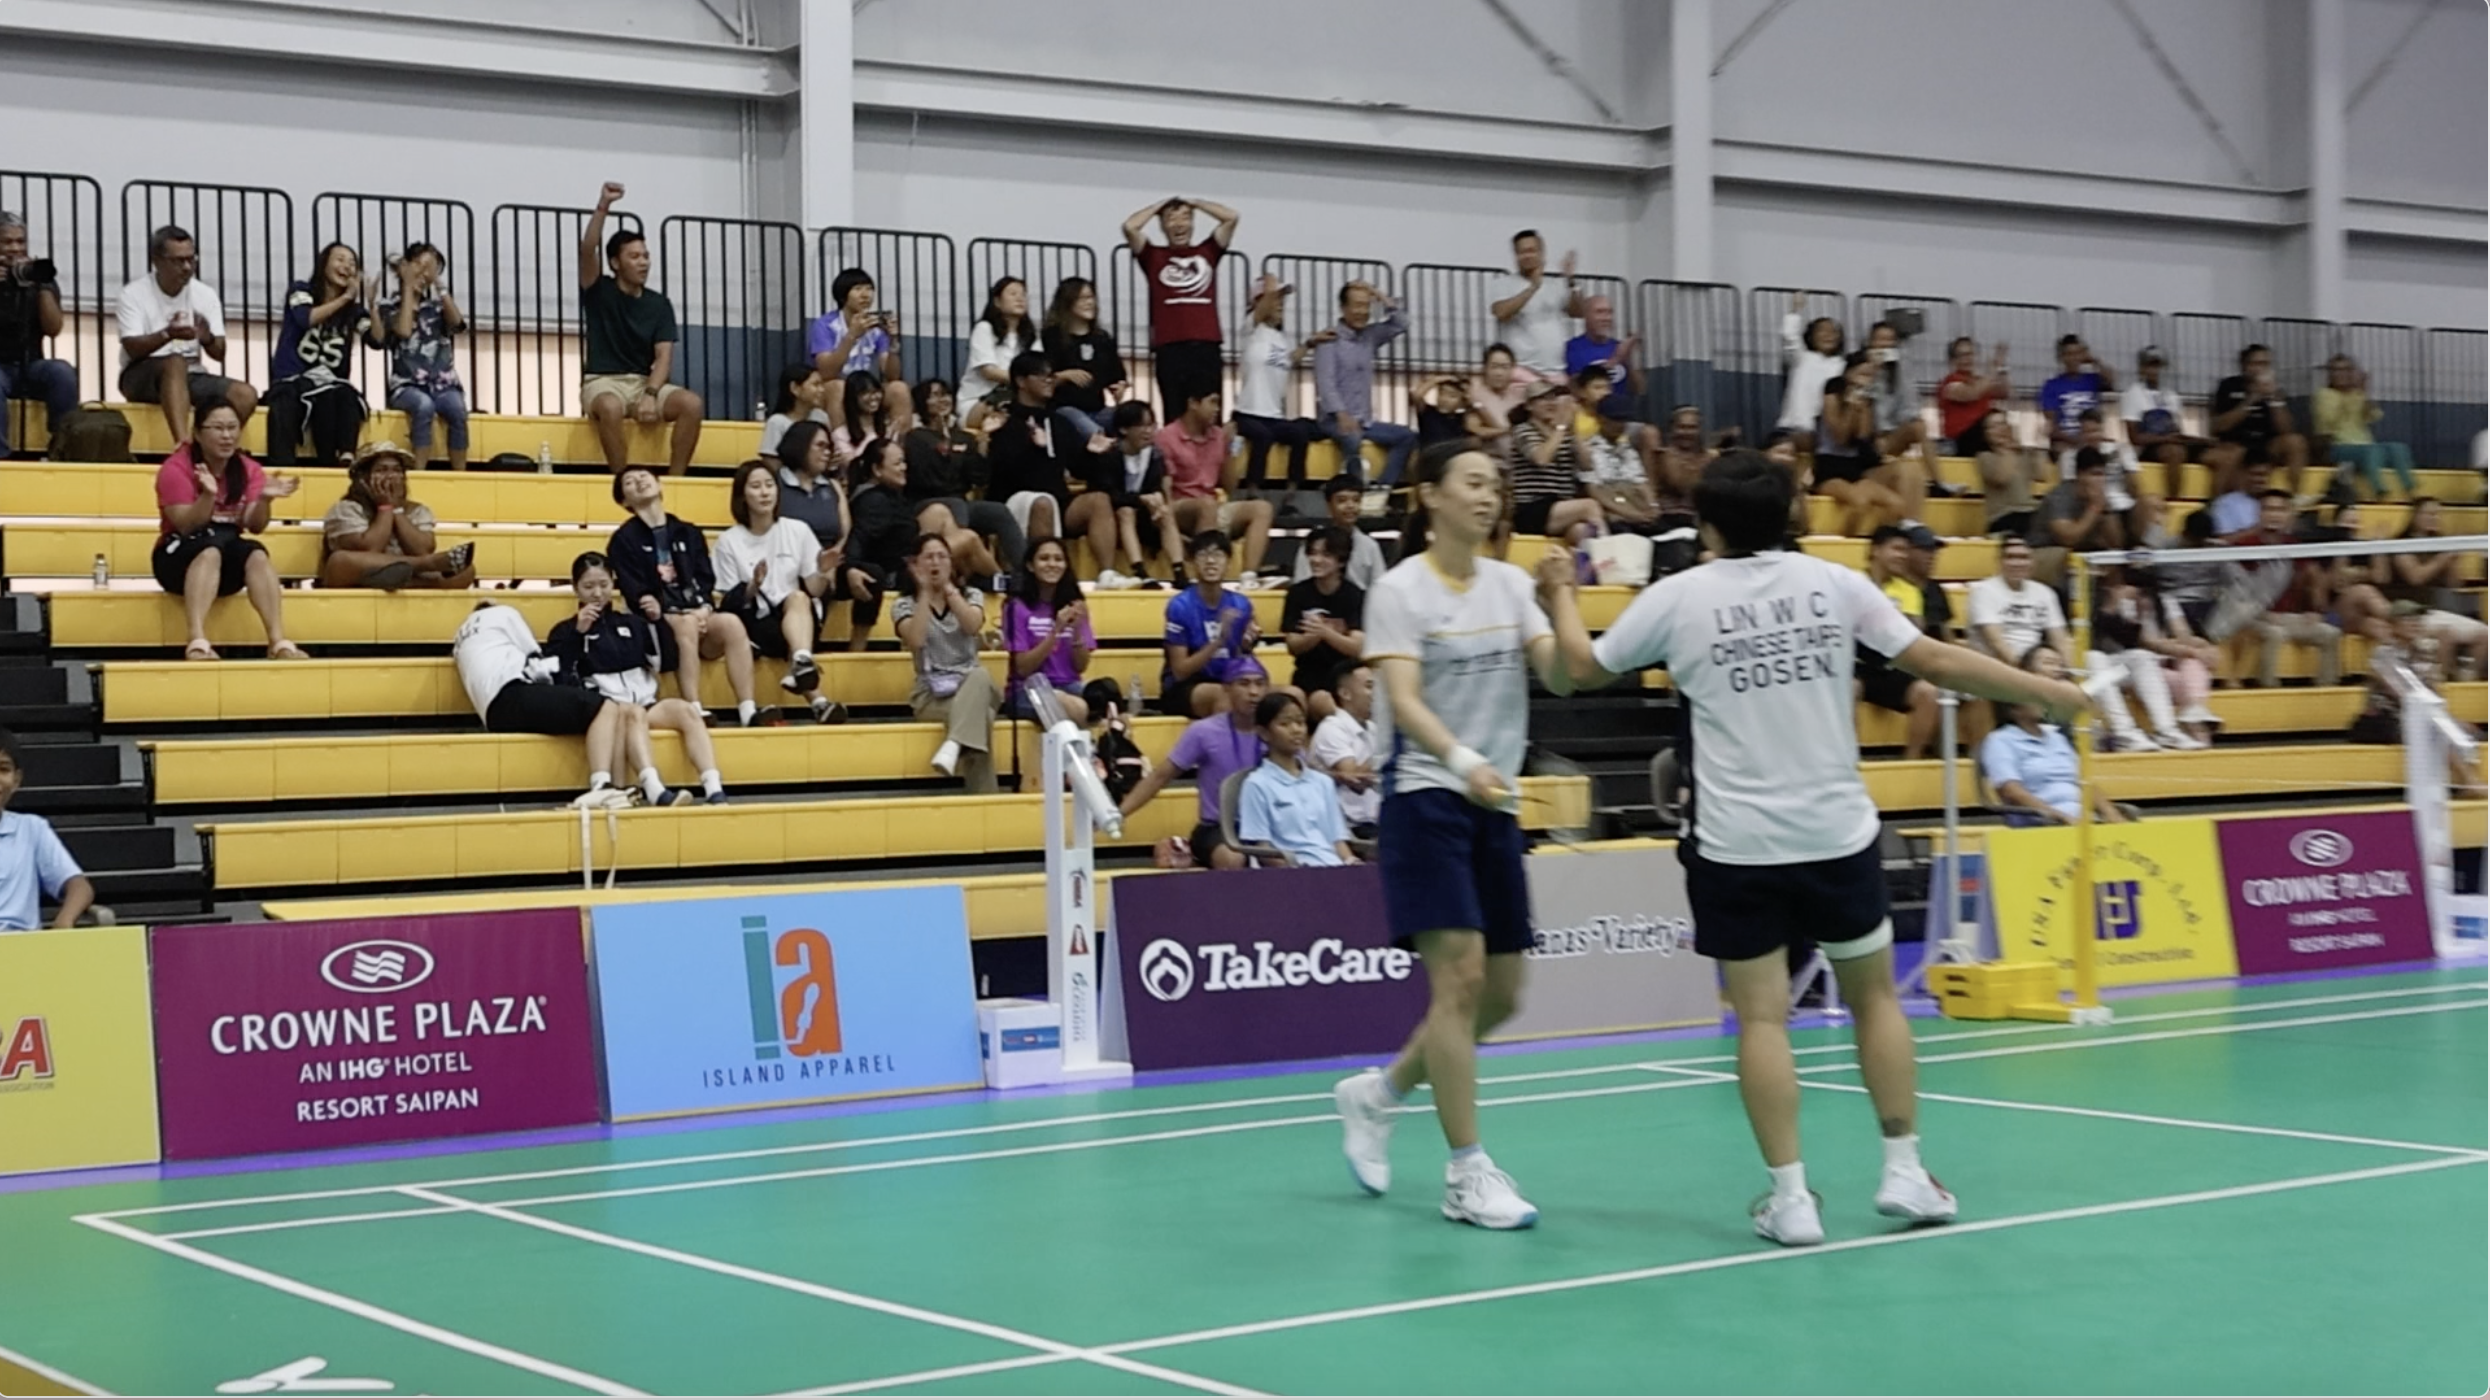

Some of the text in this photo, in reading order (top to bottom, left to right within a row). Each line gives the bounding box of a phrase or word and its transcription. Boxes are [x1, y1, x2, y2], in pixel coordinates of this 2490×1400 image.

[1713, 590, 1830, 635] LIN W C
[1710, 630, 1794, 667] CHINESE
[1197, 938, 1412, 991] TakeCare
[210, 995, 547, 1054] CROWNE PLAZA
[299, 1051, 473, 1084] AN IHG HOTEL
[702, 1054, 896, 1089] ISLAND APPAREL
[297, 1087, 479, 1123] RESORT SAIPAN
